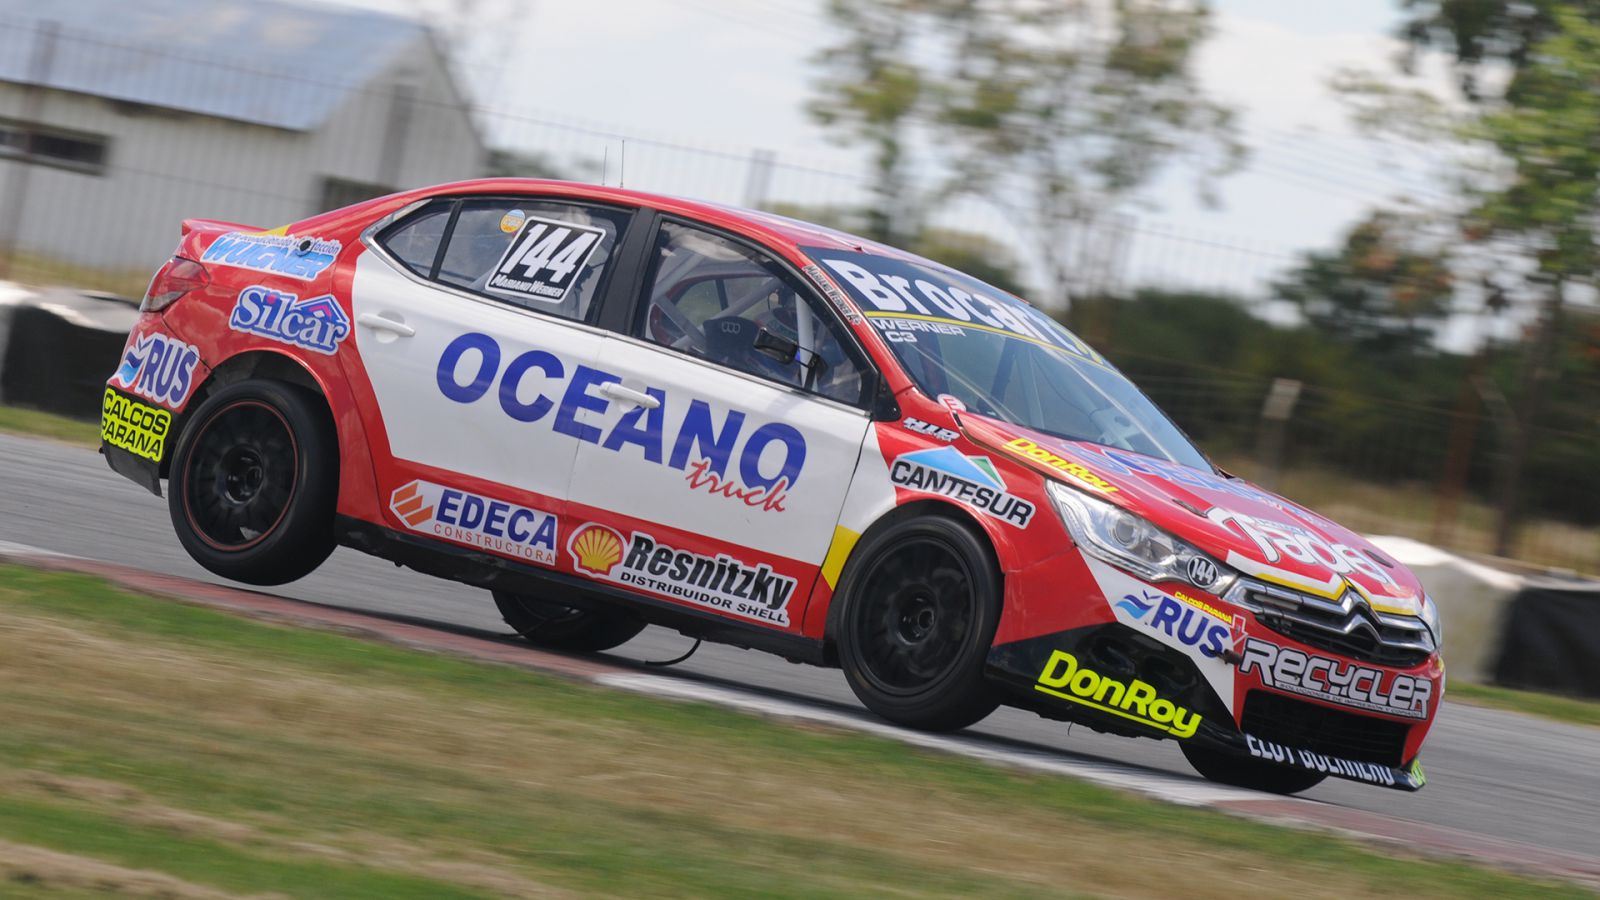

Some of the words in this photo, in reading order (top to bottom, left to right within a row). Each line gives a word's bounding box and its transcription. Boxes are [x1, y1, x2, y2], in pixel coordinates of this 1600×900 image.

[500, 223, 598, 283] 144
[491, 273, 532, 292] MARIANO
[529, 280, 565, 298] WERNER
[871, 318, 966, 336] WERNER
[885, 331, 918, 343] C3
[139, 339, 197, 403] RUS
[103, 392, 168, 436] CALCOS
[436, 332, 807, 492] OCEANO
[685, 457, 786, 512] truck
[1007, 438, 1119, 493] DonRoy
[436, 489, 556, 551] EDECA
[891, 461, 1033, 526] CANTESUR
[433, 523, 555, 565] CONSTRUCTORA
[1191, 558, 1215, 585] 144
[620, 571, 733, 609] DISTRIBUIDOR
[736, 601, 786, 625] SHELL
[623, 535, 795, 611] Resnitzky
[1151, 596, 1229, 658] RUS
[1038, 649, 1202, 738] DonRoy
